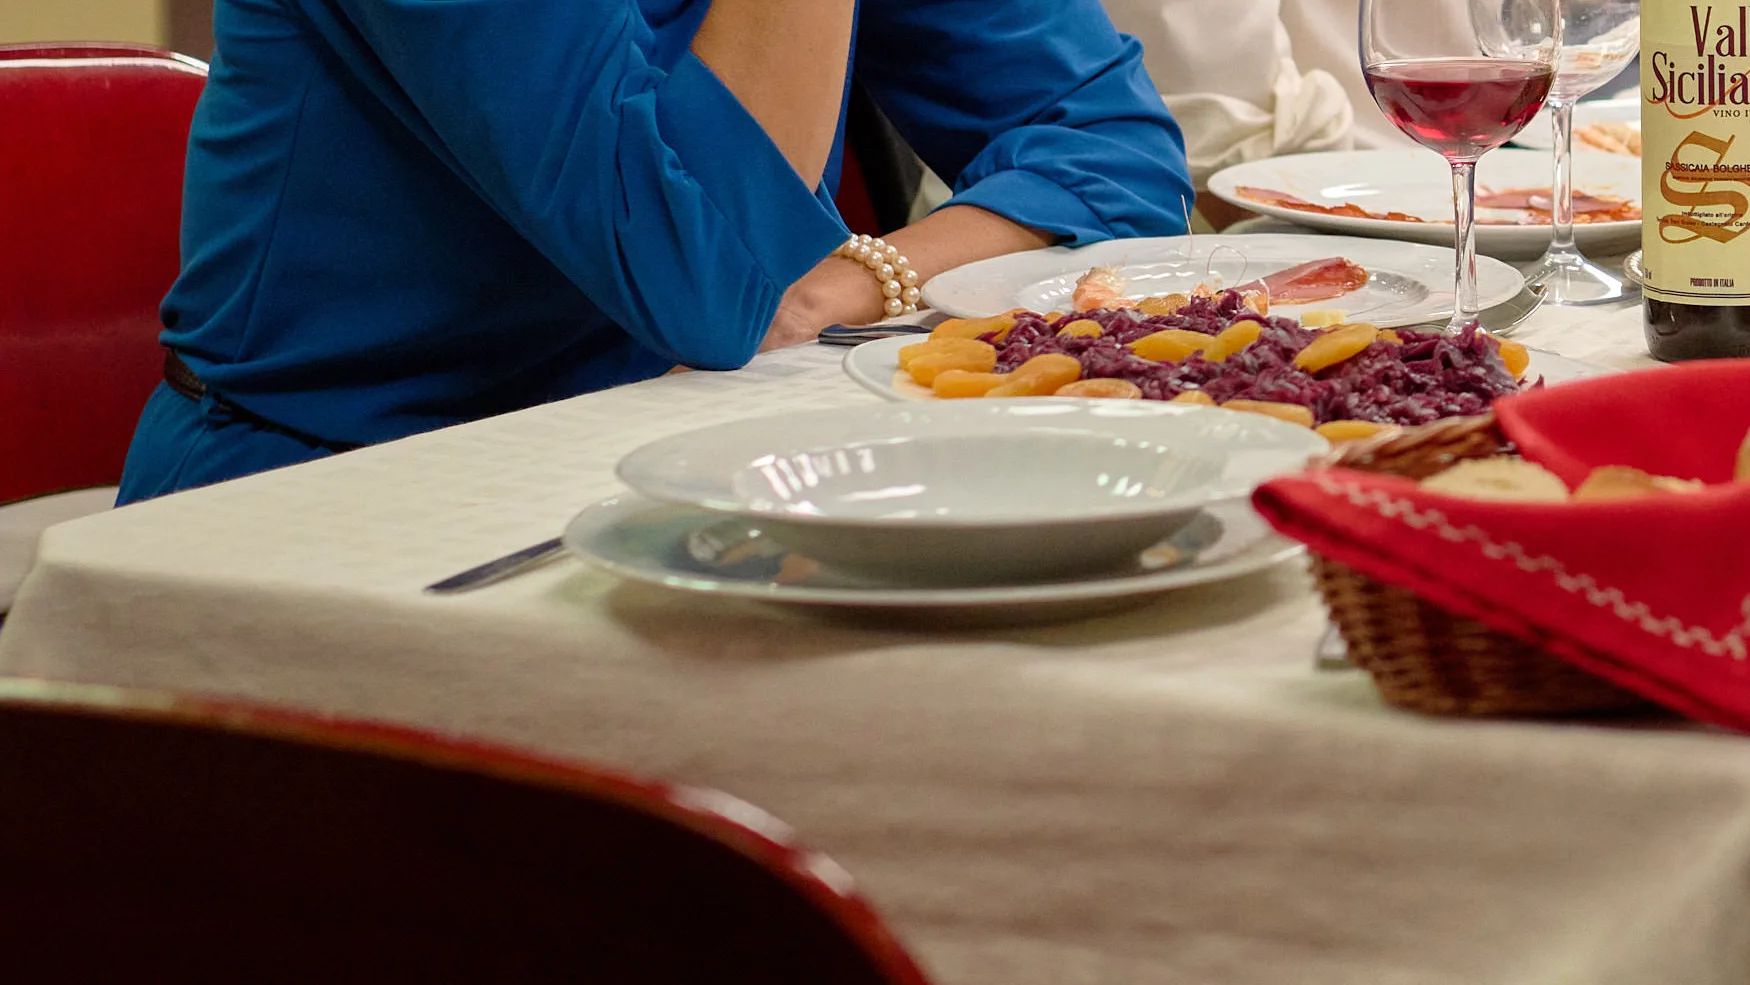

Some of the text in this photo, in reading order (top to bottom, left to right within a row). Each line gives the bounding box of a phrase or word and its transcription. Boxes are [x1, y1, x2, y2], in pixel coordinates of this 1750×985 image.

[1652, 51, 1750, 106] Sicilia
[1713, 109, 1741, 119] VINO
[1665, 162, 1709, 173] SASSICAIA
